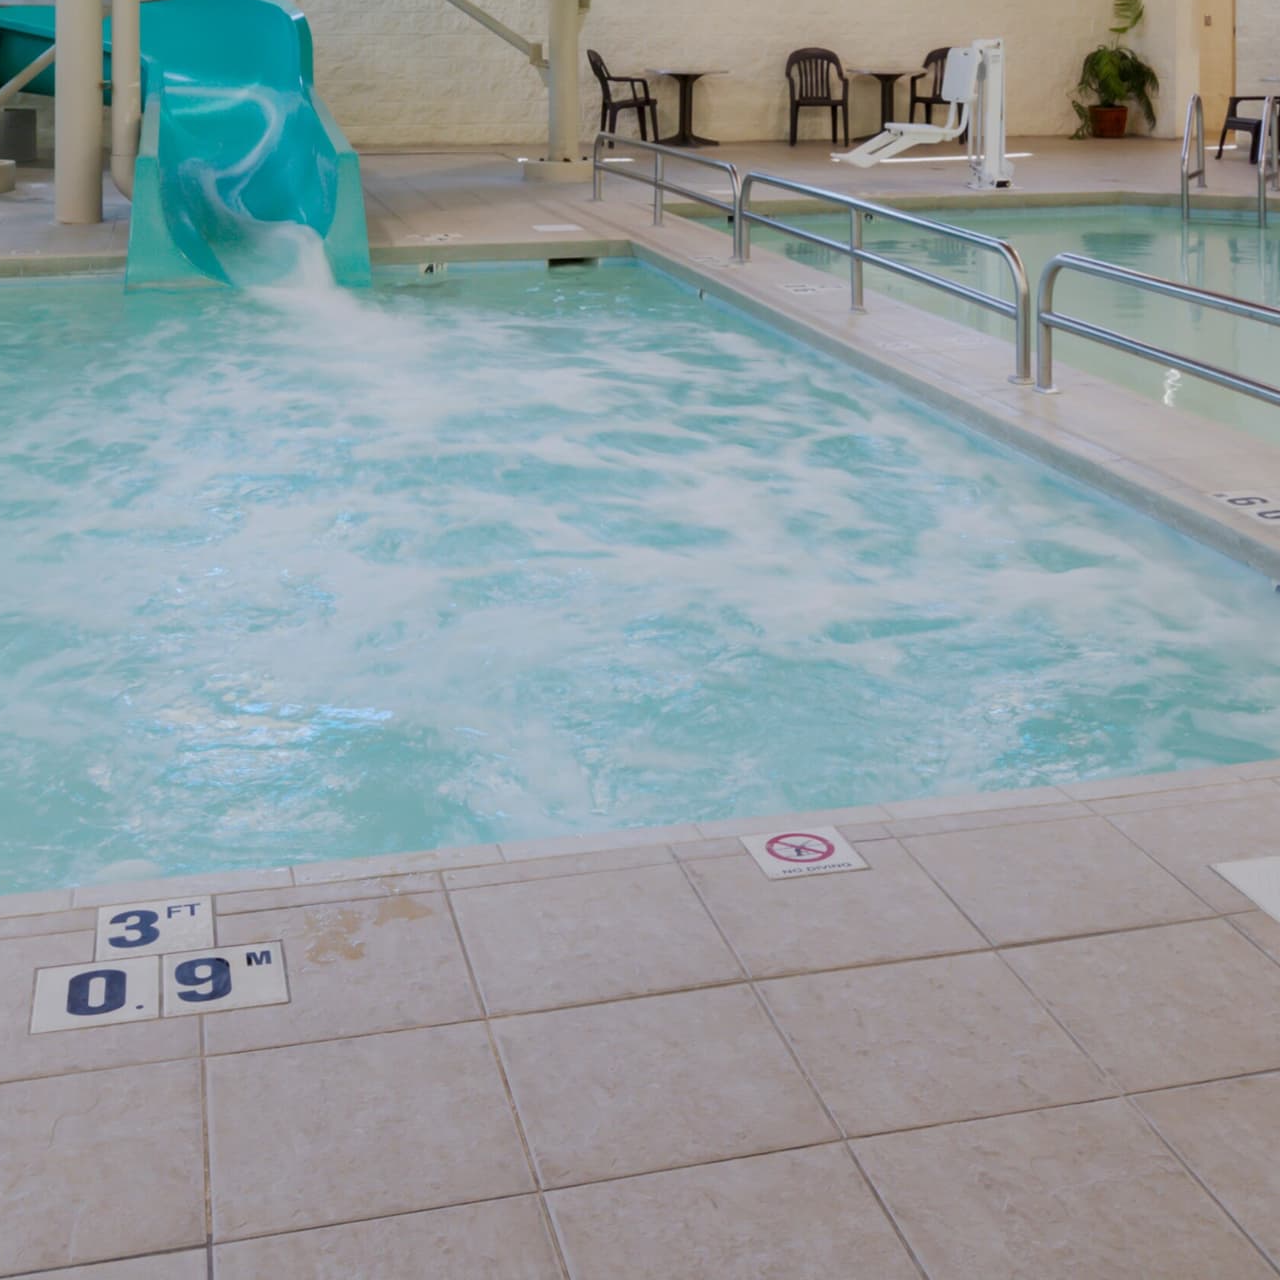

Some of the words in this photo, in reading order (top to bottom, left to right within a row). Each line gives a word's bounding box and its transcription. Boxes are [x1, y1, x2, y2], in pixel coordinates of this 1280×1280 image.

[806, 862, 852, 872] DIVING
[108, 909, 161, 949] 3
[167, 902, 201, 919] FT
[66, 957, 232, 1016] 0.9
[246, 950, 272, 966] M
